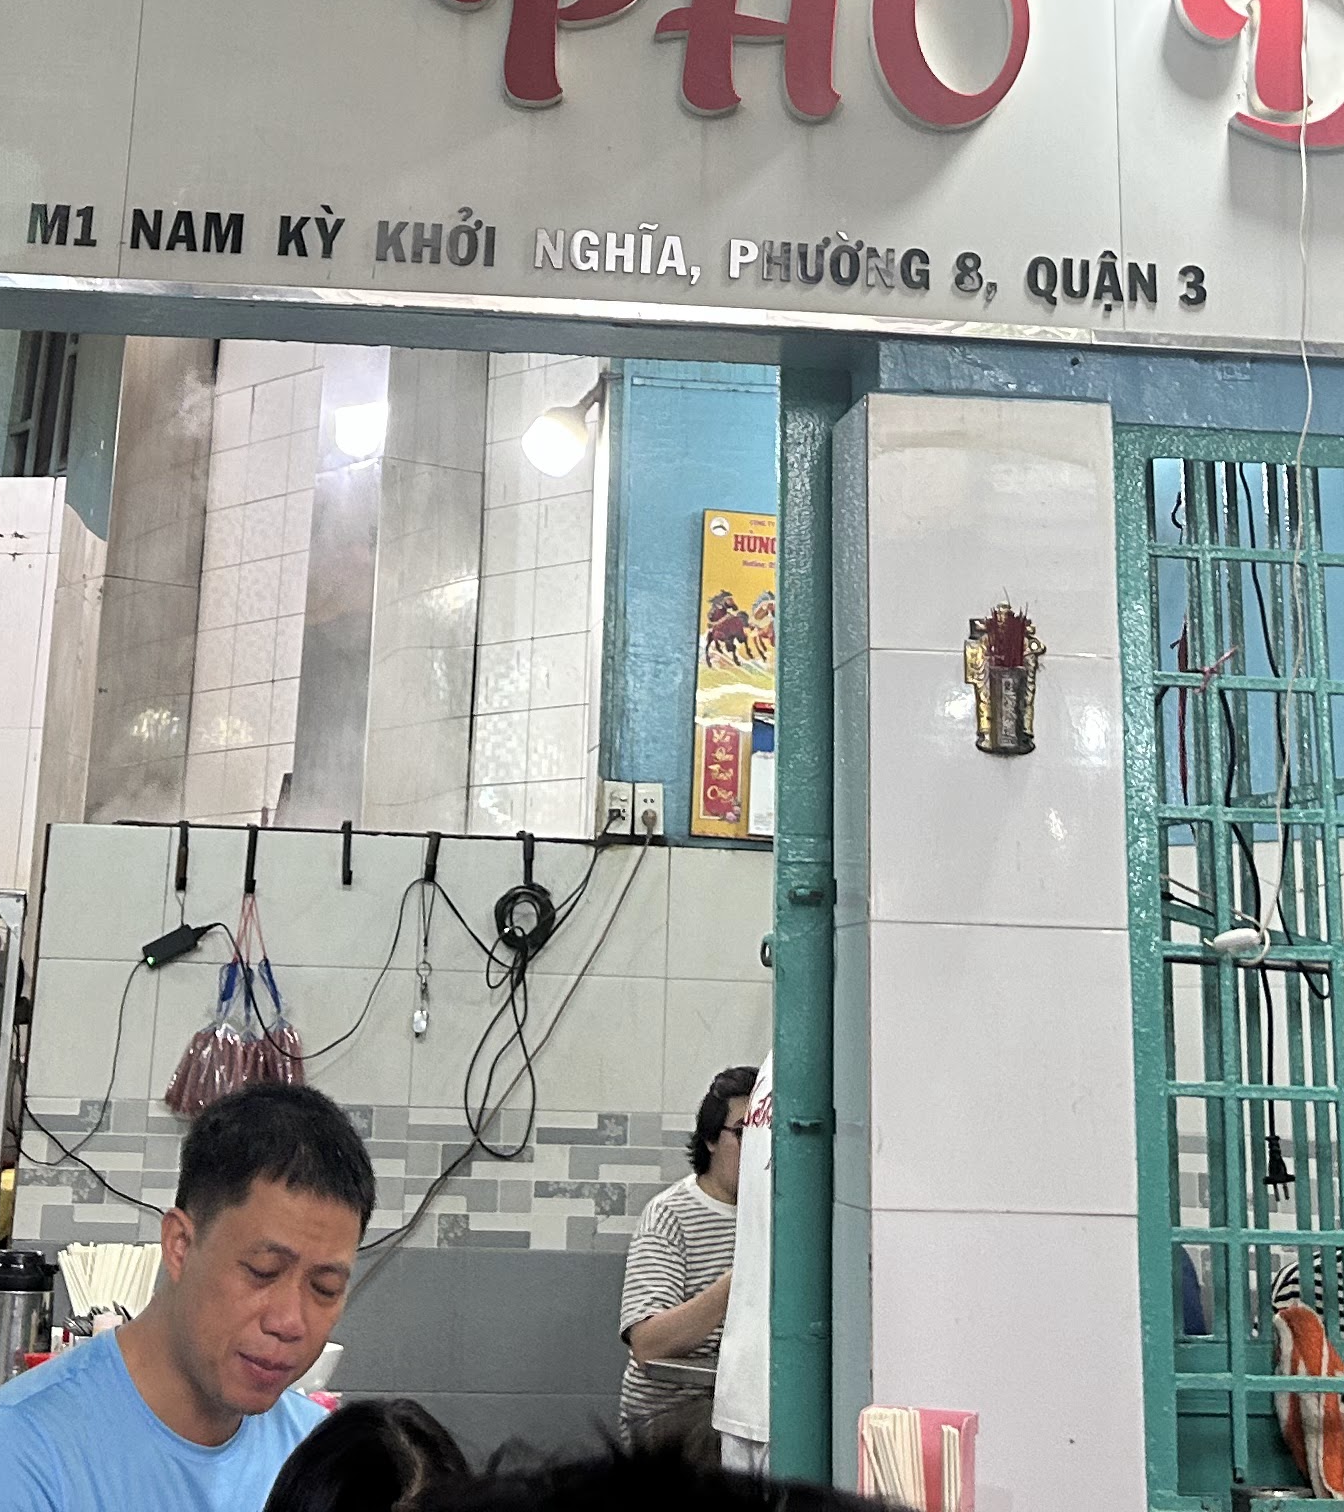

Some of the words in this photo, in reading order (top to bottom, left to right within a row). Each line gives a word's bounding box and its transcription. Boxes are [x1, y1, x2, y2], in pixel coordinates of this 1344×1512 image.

[27, 203, 97, 247] M1
[130, 208, 244, 254] NAM
[277, 205, 345, 259] KỲ
[375, 206, 496, 267] KHỞI
[534, 222, 702, 286] NGHĨA,
[729, 230, 931, 291] PHƯỜNG
[956, 252, 997, 303] 8,
[1026, 250, 1157, 312] QUẬN
[1178, 265, 1207, 306] 3
